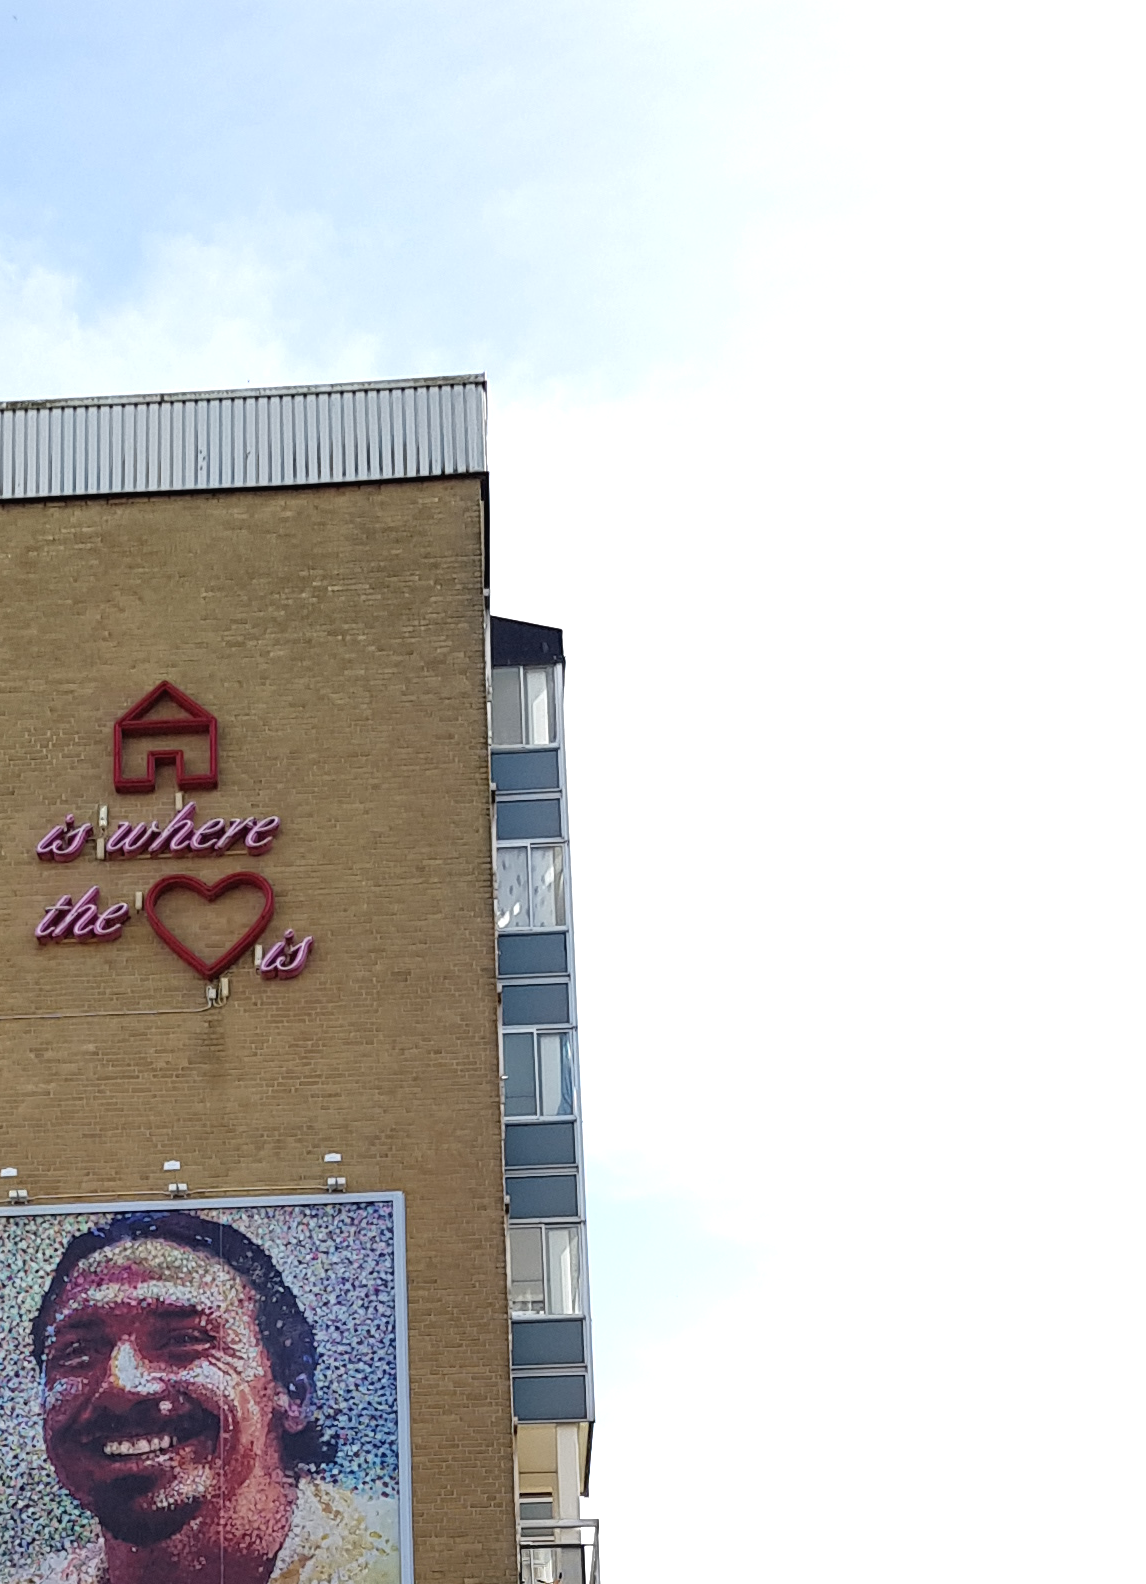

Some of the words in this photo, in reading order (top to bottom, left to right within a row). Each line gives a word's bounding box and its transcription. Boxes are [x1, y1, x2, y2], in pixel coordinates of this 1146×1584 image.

[37, 813, 94, 862] is
[106, 801, 281, 860] where
[35, 885, 130, 945] the
[260, 928, 315, 980] is
